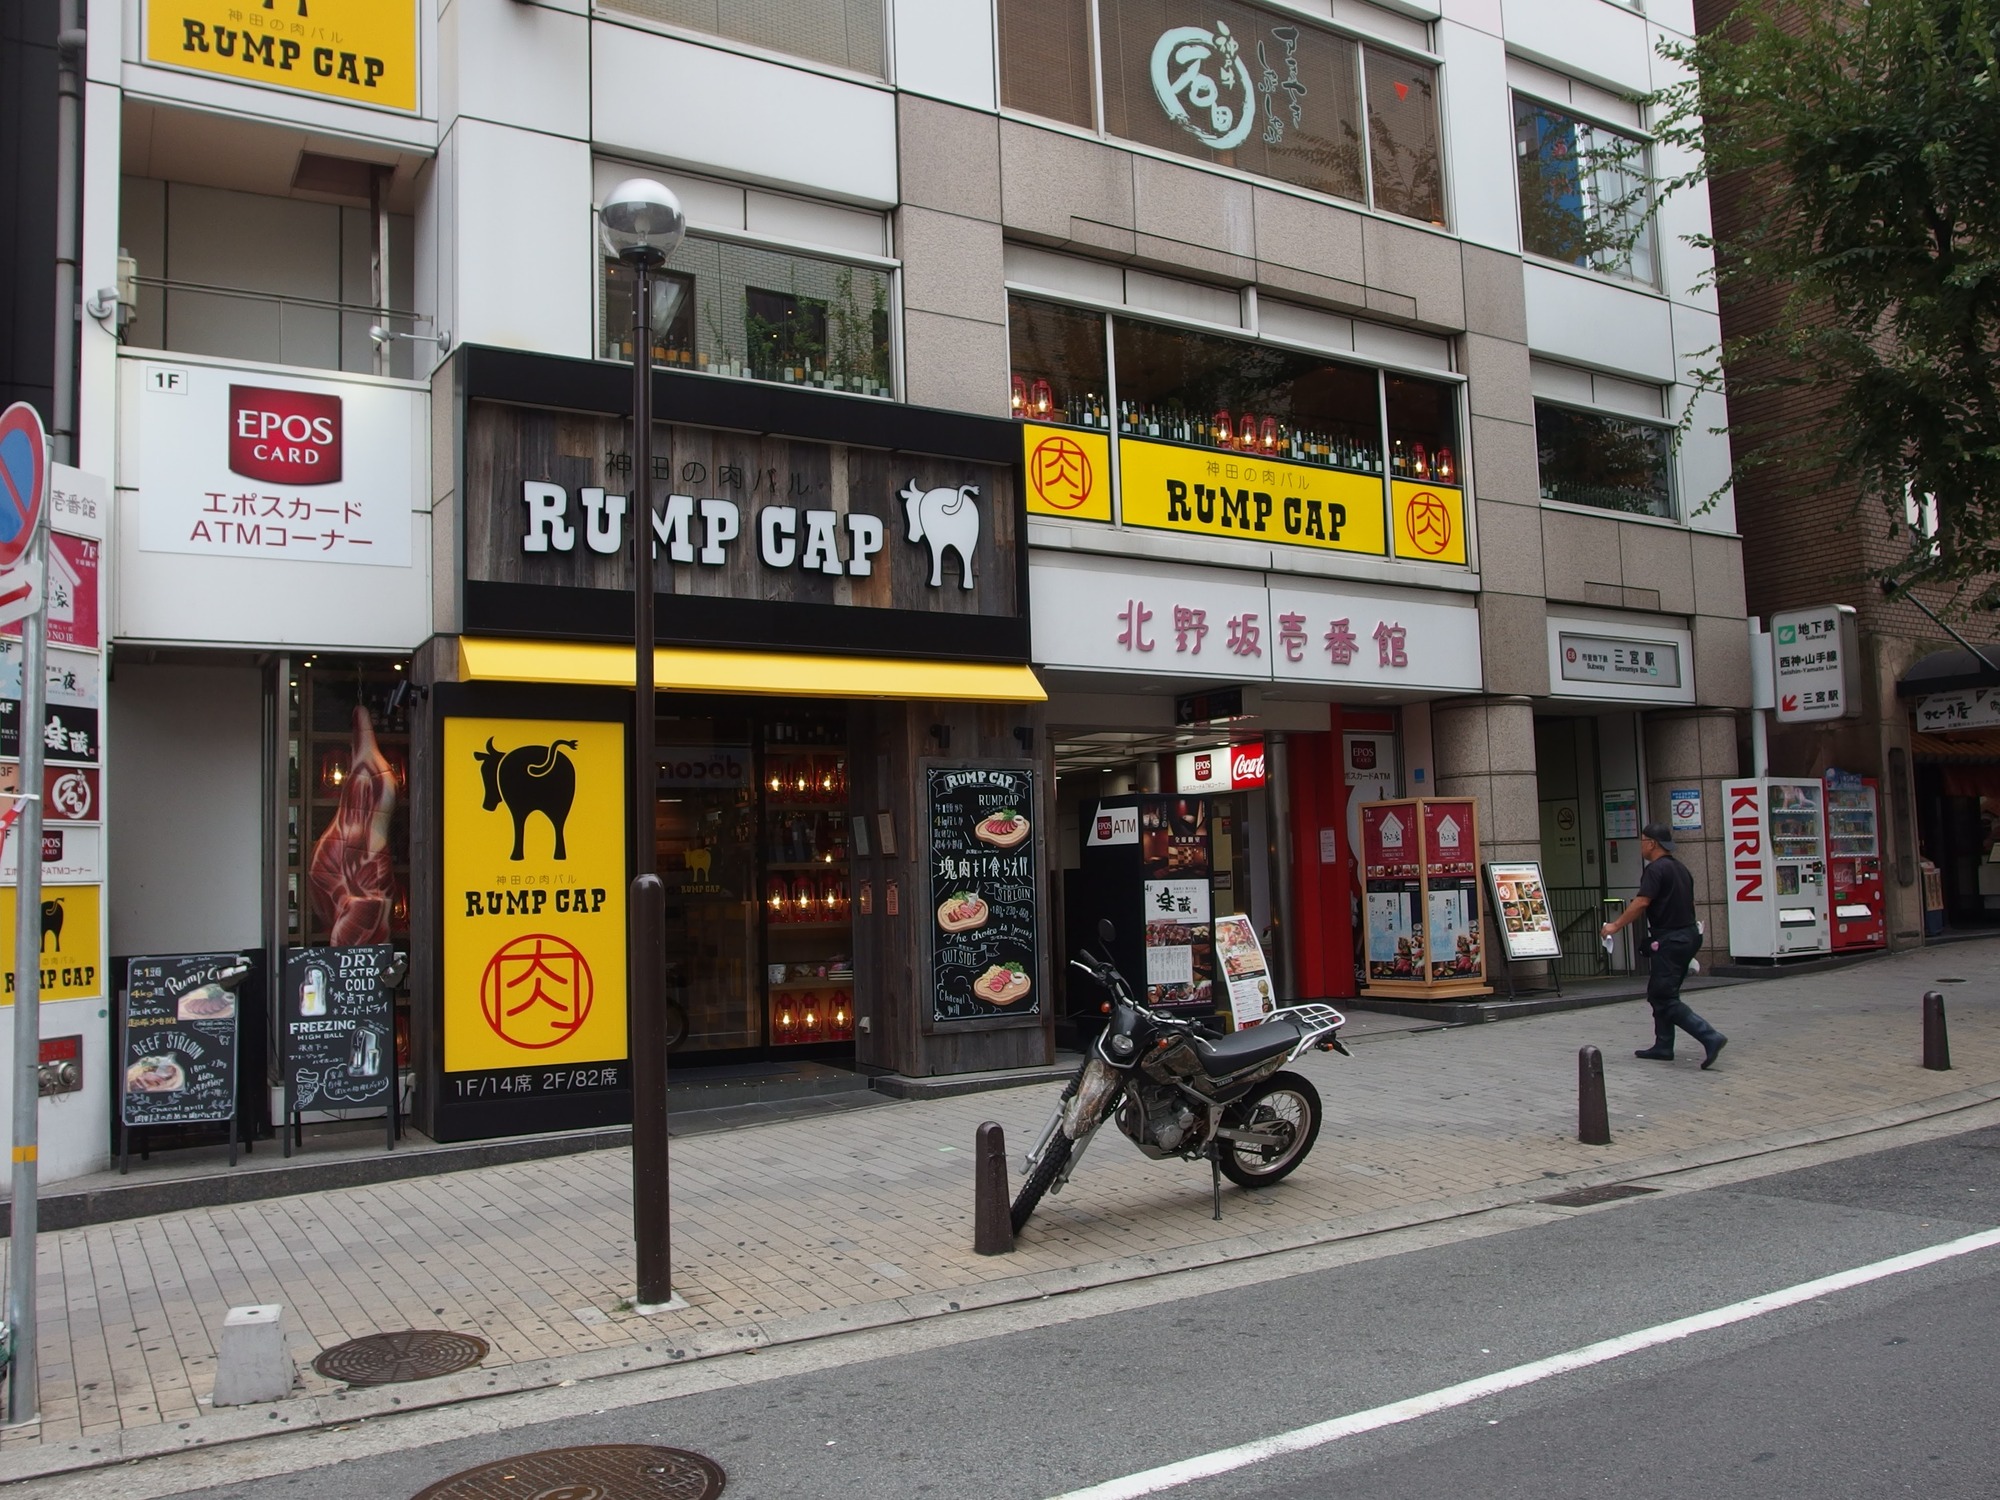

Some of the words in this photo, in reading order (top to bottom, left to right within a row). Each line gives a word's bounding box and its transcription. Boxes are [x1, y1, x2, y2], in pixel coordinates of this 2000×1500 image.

[228, 8, 343, 44] 神田の肉バル
[182, 18, 300, 70] RUMP
[313, 47, 384, 87] CAP
[155, 372, 179, 389] 1F
[238, 409, 333, 445] EPOS
[253, 444, 319, 465] CARD
[605, 449, 811, 497] 神田の肉バル
[1033, 437, 1091, 506] 肉
[1205, 460, 1311, 491] 神田の肉バル
[203, 492, 362, 525] エポスカード
[1166, 479, 1273, 533] RUMP
[1284, 497, 1347, 542] CAP
[521, 479, 740, 566] RUMP
[758, 504, 884, 577] CAP
[1407, 492, 1451, 554] 肉
[190, 520, 372, 551] ATMコーナー
[81, 541, 96, 558] 7F
[1117, 599, 1409, 668] 北野坂壱番館
[1798, 619, 1835, 635] 地下鉄
[1805, 633, 1827, 641] Subway
[1587, 663, 1605, 672] Subway
[1614, 649, 1655, 666] 三宮駅
[1803, 690, 1838, 704] 三宮駅
[1353, 747, 1374, 757] EPOS
[1, 767, 13, 777] 3F
[1196, 760, 1211, 770] EPOS
[947, 772, 987, 788] RUMP
[989, 772, 1014, 788] CAP
[979, 795, 1003, 806] RUMP
[1004, 794, 1019, 806] CAP
[1097, 822, 1112, 832] EPOS
[1113, 818, 1136, 834] ATM
[42, 837, 61, 849] POS
[1731, 786, 1763, 902] KIRIN
[496, 874, 576, 886] 神田の肉バル
[465, 889, 547, 917] RUMP
[555, 888, 606, 914] CAP
[62, 966, 94, 987] CAP
[165, 971, 205, 995] Rump
[339, 968, 380, 978] EXTRA
[345, 979, 375, 992] COLD
[488, 936, 588, 1038] 肉
[289, 1020, 356, 1035] FREEZING
[132, 1035, 161, 1056] BEEF
[167, 1034, 205, 1060] SIRLOIN
[455, 1073, 532, 1096] 1F/14席
[543, 1067, 618, 1091] 2F/82席
